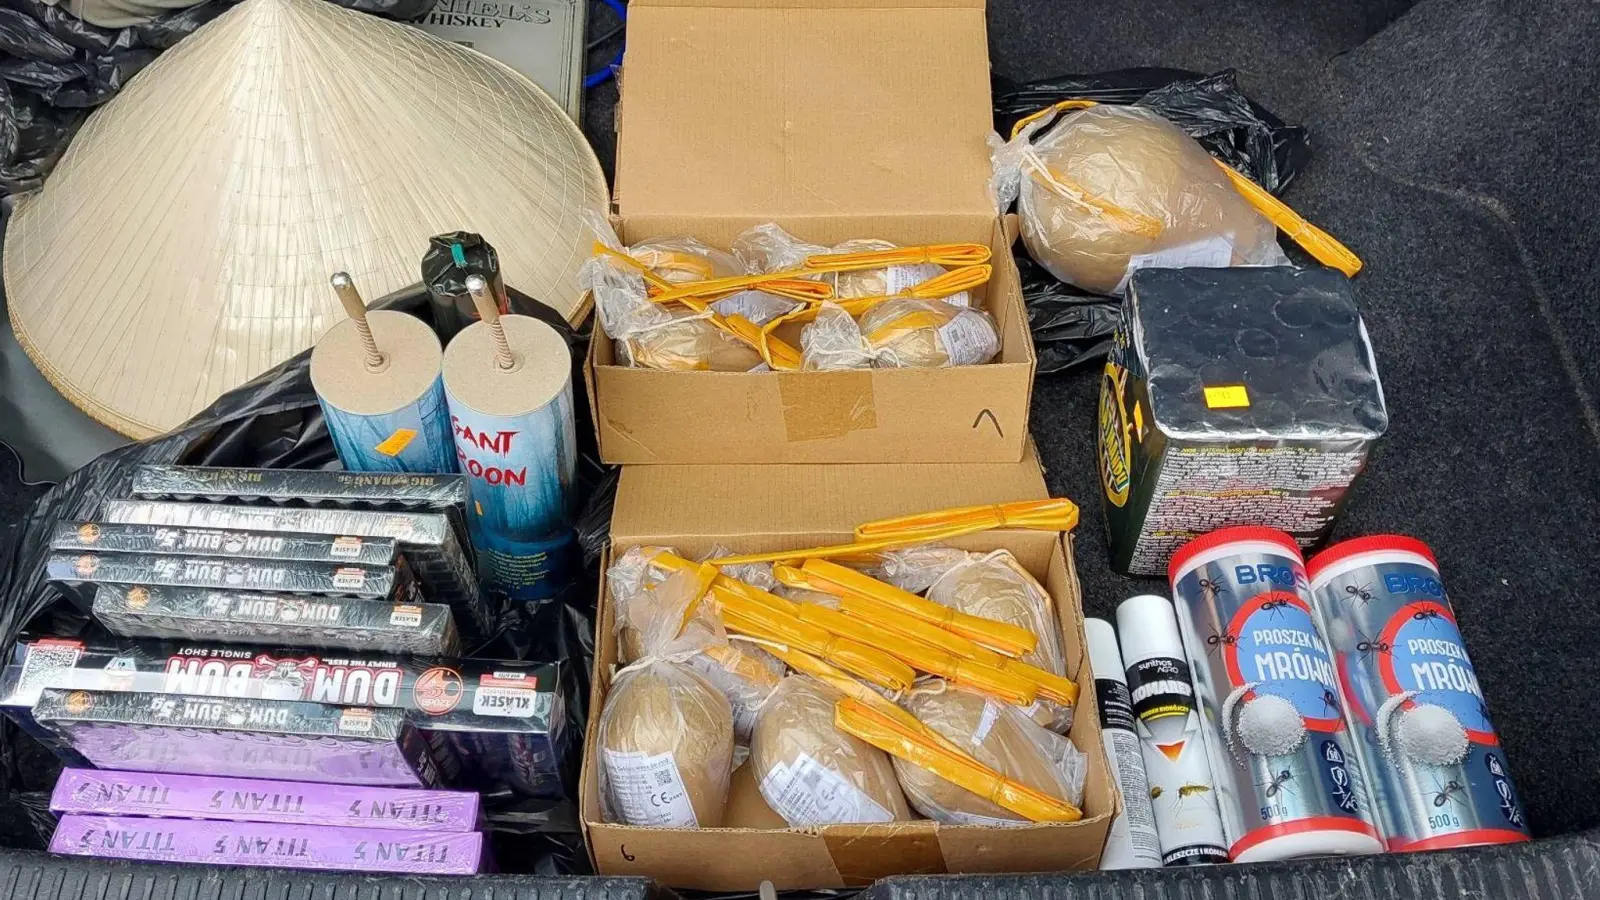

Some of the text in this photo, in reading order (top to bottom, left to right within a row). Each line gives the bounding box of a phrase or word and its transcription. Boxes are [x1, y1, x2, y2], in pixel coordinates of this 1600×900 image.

[154, 528, 283, 552] DUM BUM 5g
[153, 559, 285, 583] DUM BUM 5g
[1384, 573, 1447, 597] BRO
[238, 600, 277, 617] BUM
[301, 603, 340, 620] DUM
[1253, 629, 1312, 648] PROSZEK
[177, 647, 251, 658] SINGLE SHOT
[1408, 639, 1464, 660] PROSZEK
[1138, 660, 1173, 670] synthos
[164, 659, 400, 705] DUM BUM
[150, 697, 288, 725] DUM BUM 5g
[96, 783, 170, 805] TITAN
[231, 792, 304, 814] TITAN
[370, 801, 444, 823] TITAN
[1261, 804, 1280, 820] 500
[1428, 813, 1460, 830] 500 g
[101, 830, 175, 851] TITAN
[235, 836, 308, 857] TITAN
[375, 842, 448, 863] TITAN
